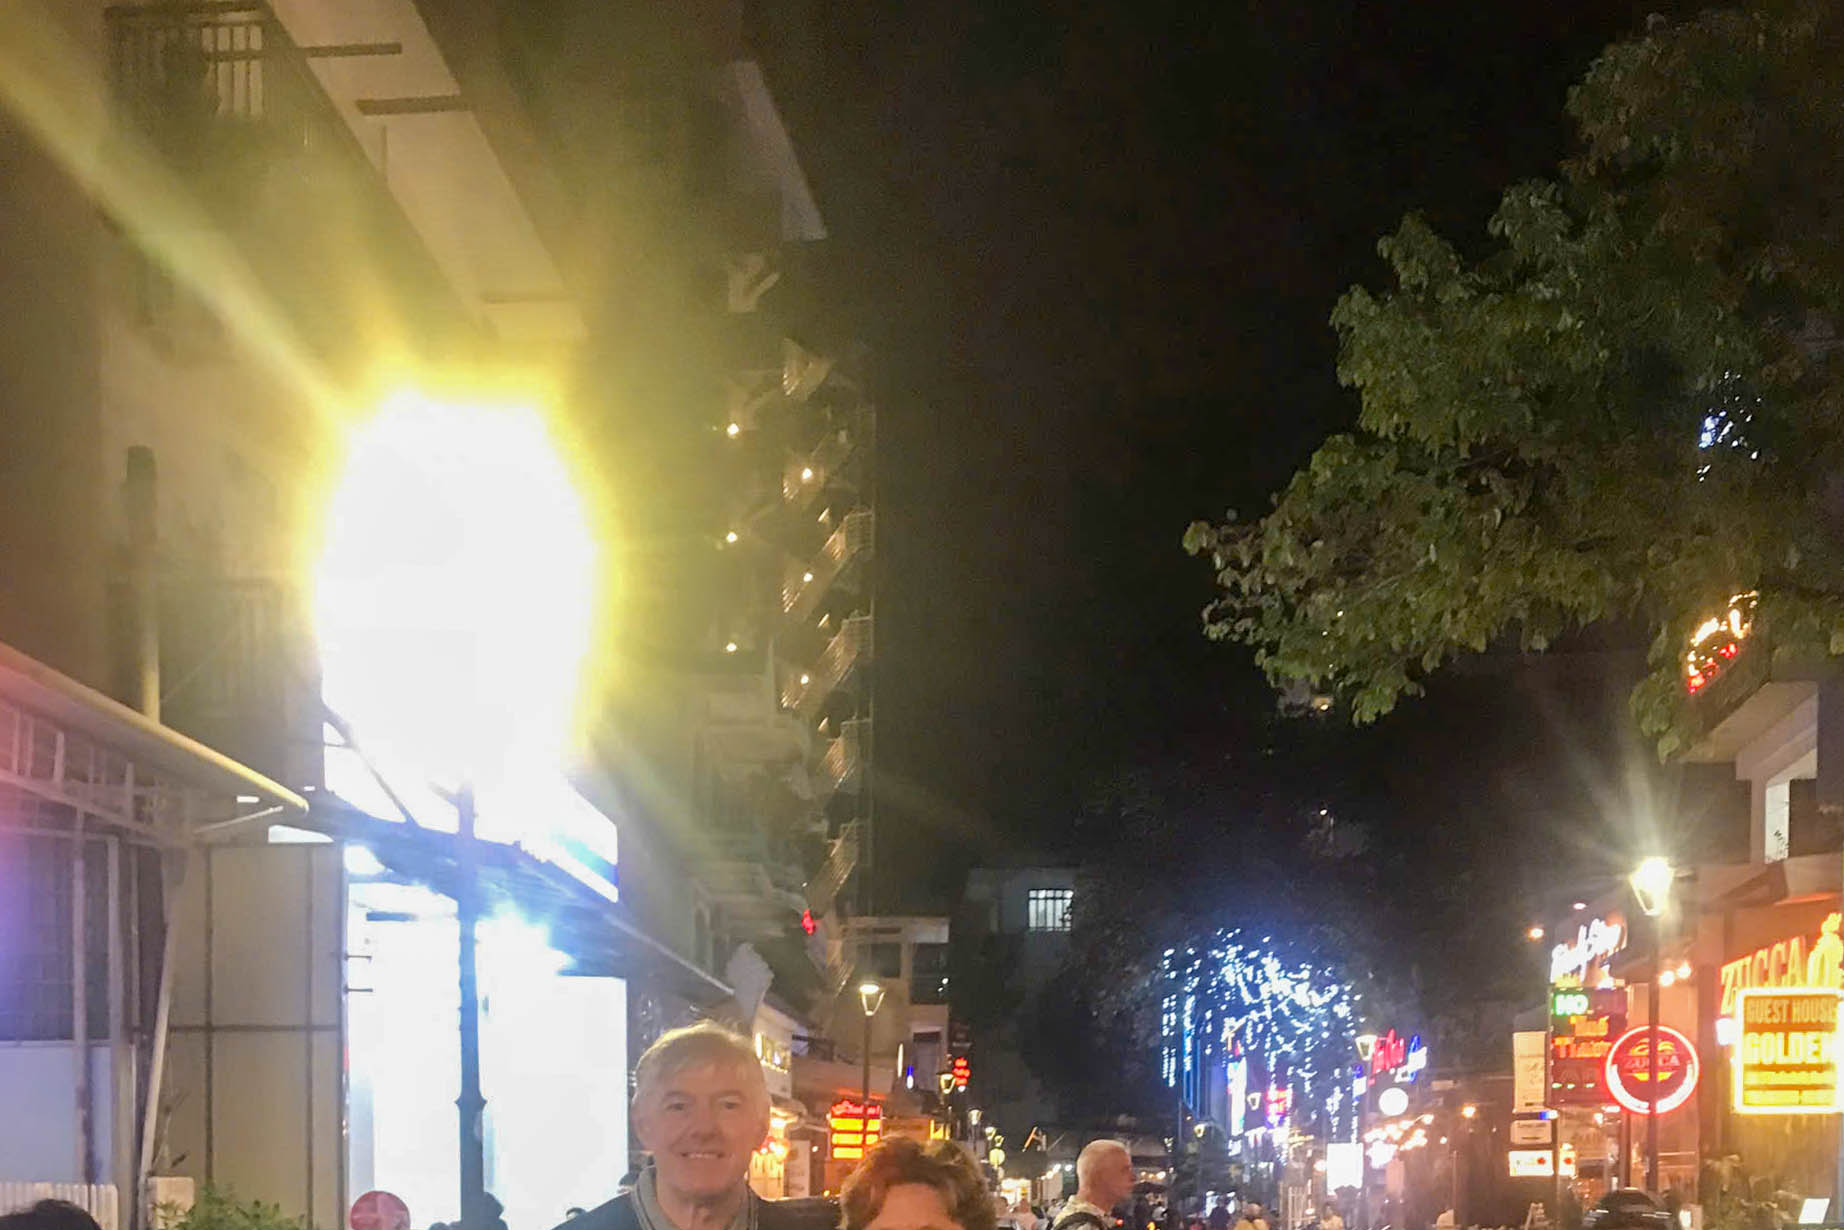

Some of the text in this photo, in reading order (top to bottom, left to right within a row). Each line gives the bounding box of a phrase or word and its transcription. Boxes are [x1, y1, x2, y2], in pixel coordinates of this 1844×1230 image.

[1720, 935, 1806, 1015] ZUCCA
[1747, 998, 1789, 1024] GUEST
[1623, 1055, 1681, 1069] ZUCA
